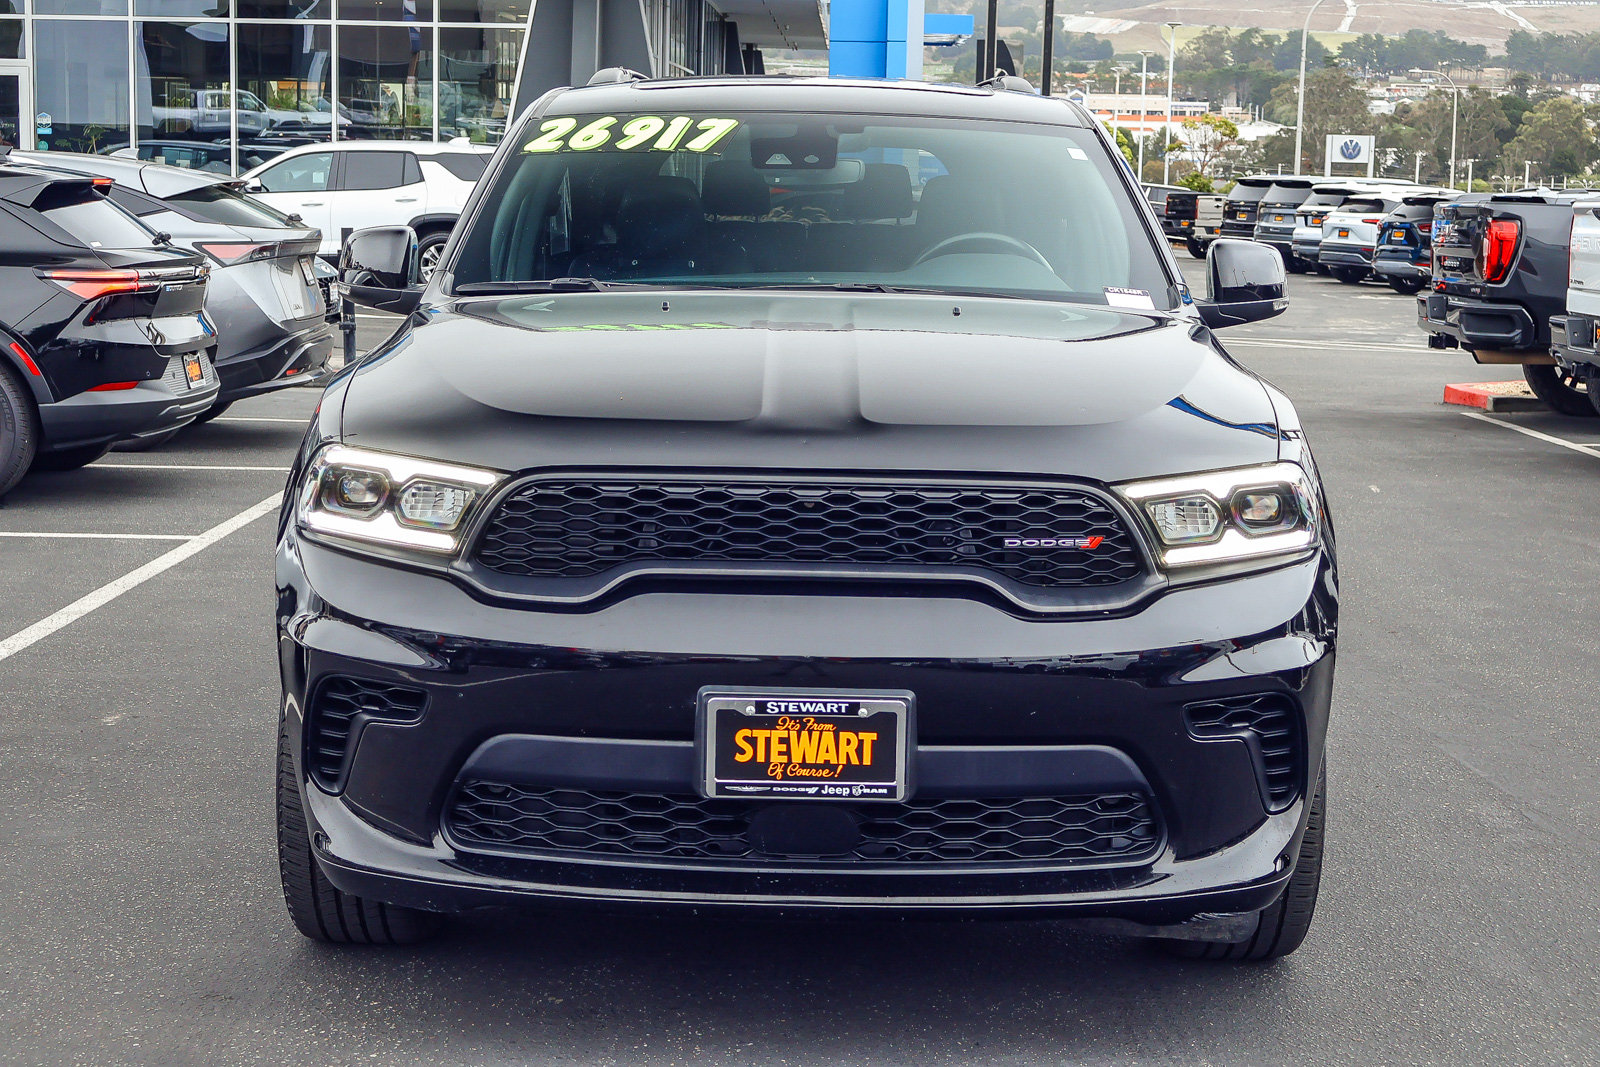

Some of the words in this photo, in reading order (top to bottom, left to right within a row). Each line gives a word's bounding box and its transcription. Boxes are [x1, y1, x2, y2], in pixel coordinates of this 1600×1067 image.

[523, 116, 739, 152] 26917
[1004, 539, 1091, 547] DODGE
[766, 701, 849, 713] STEWART
[776, 716, 801, 731] It's
[802, 717, 837, 731] From
[734, 728, 878, 766] STEWART
[767, 762, 785, 780] Of
[821, 785, 850, 796] Jeep
